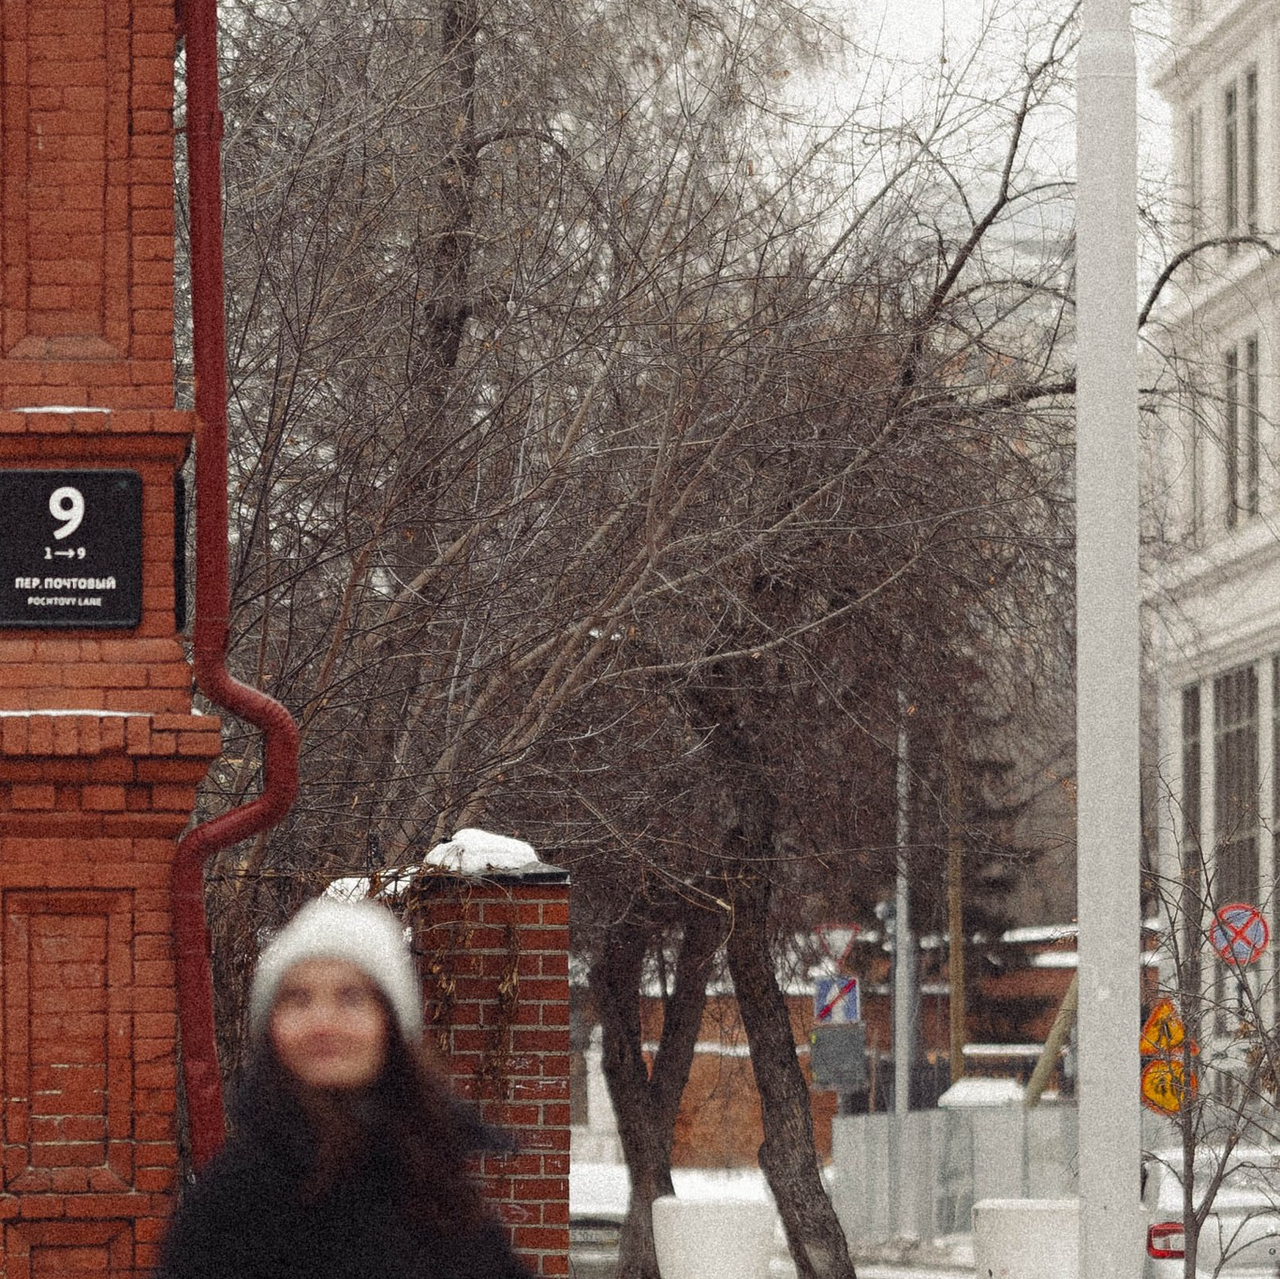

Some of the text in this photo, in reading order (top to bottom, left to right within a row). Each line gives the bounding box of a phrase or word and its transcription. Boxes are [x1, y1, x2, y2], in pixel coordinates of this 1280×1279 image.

[49, 486, 85, 540] 9
[44, 547, 86, 560] 1 9
[15, 576, 117, 590] ПЕР. ПОЧТОВЫЙ
[78, 597, 102, 607] LANE
